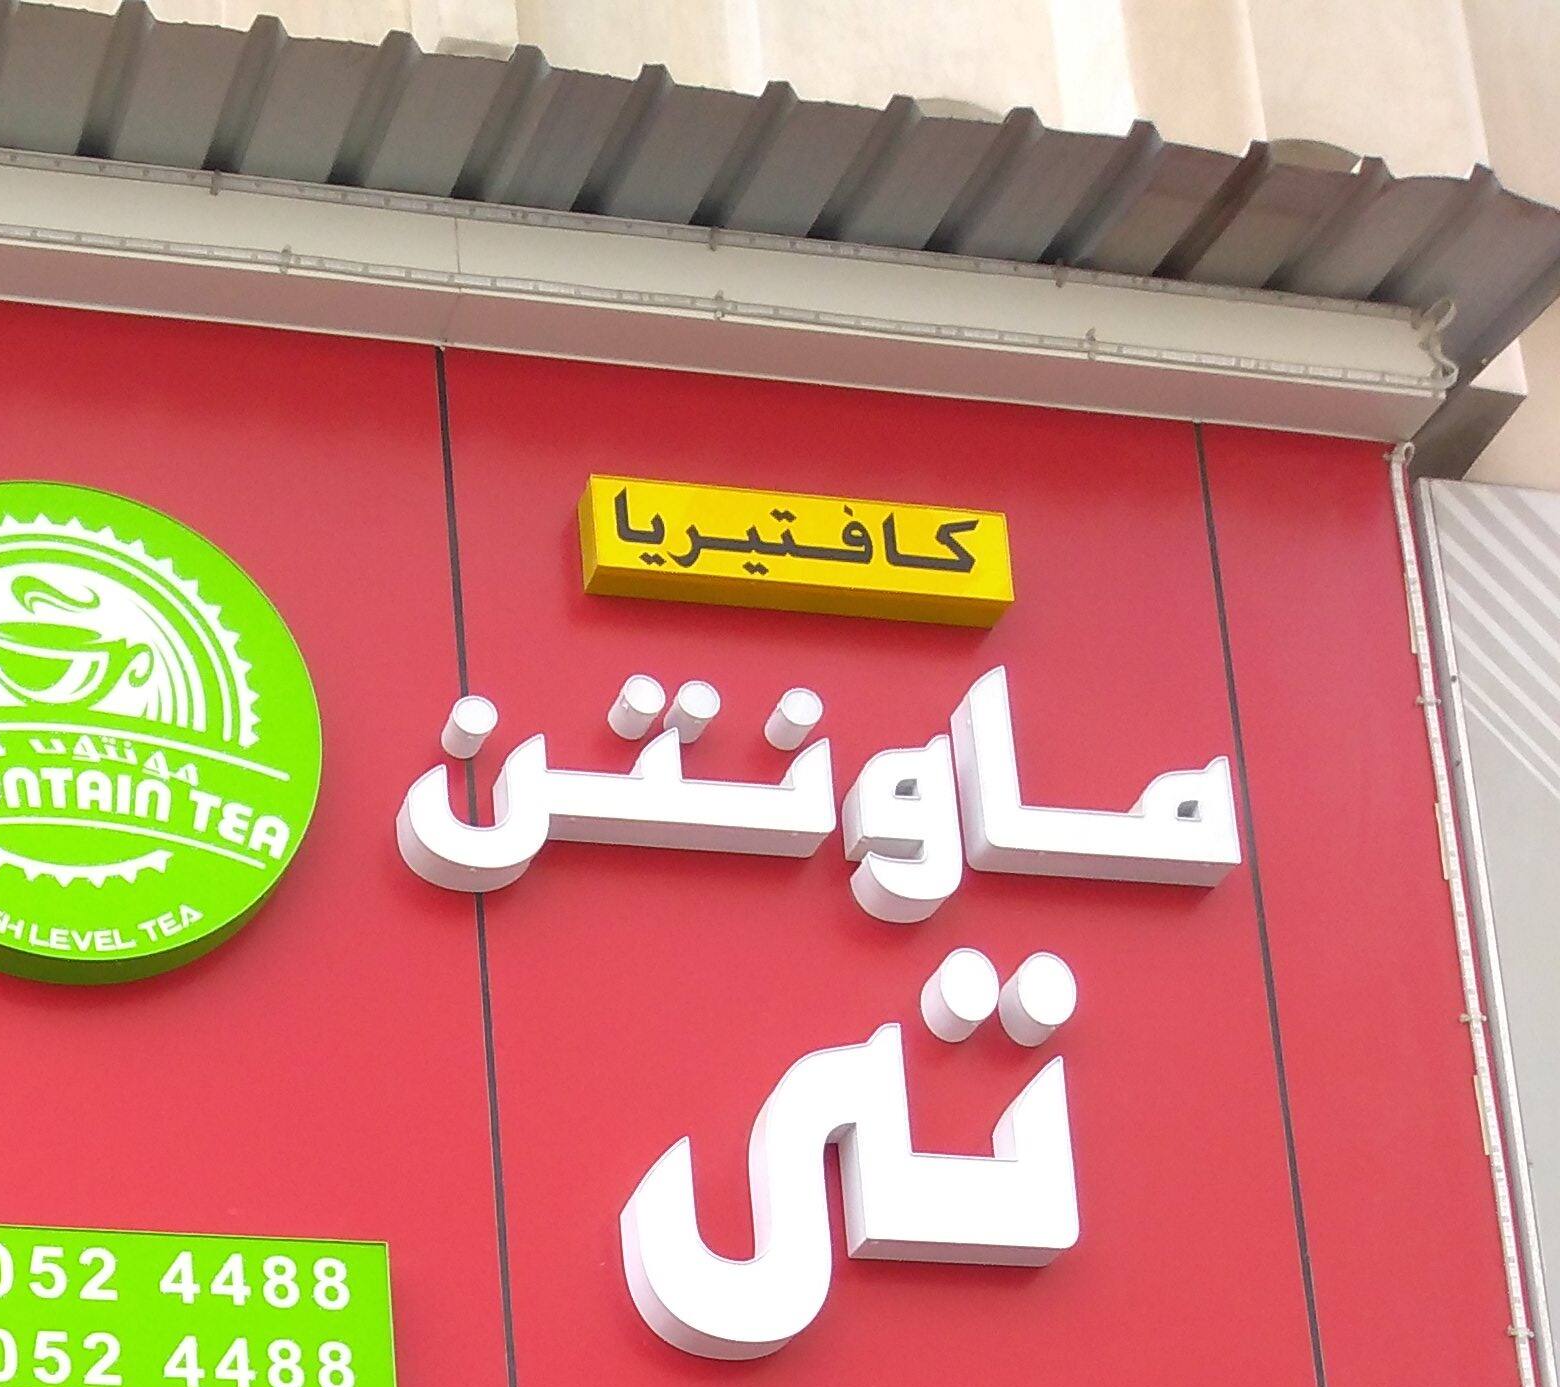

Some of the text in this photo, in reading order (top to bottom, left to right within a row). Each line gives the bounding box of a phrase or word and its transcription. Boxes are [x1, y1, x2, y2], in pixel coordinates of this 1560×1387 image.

[616, 488, 980, 577] كافتيريا
[189, 790, 291, 860] TEA
[396, 665, 1242, 924] ماونتن
[29, 928, 138, 952] LEVEL
[138, 904, 204, 943] TEA
[158, 1250, 351, 1311] 4488
